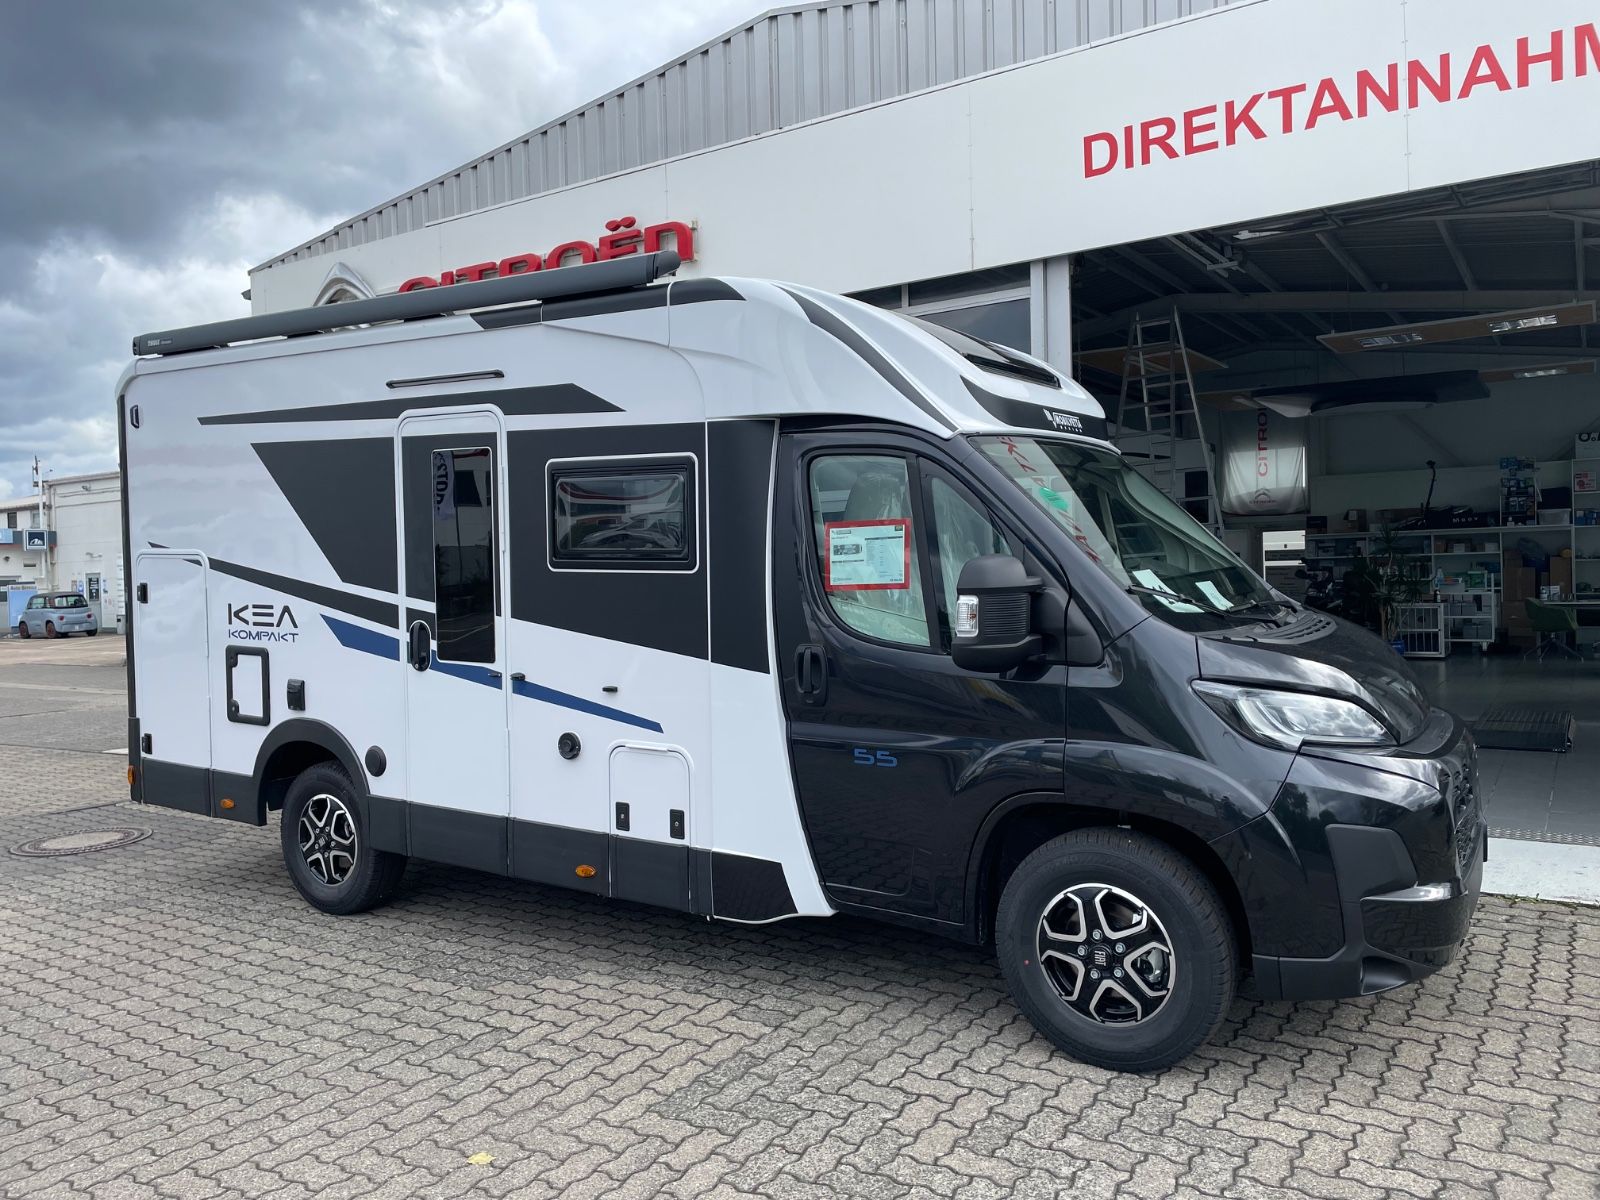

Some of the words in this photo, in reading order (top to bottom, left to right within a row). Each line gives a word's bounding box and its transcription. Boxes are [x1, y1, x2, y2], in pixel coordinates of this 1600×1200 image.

[227, 603, 299, 628] KEA
[228, 629, 299, 642] KOMPAKT
[854, 748, 897, 767] 55
[1094, 950, 1106, 967] FIAT
